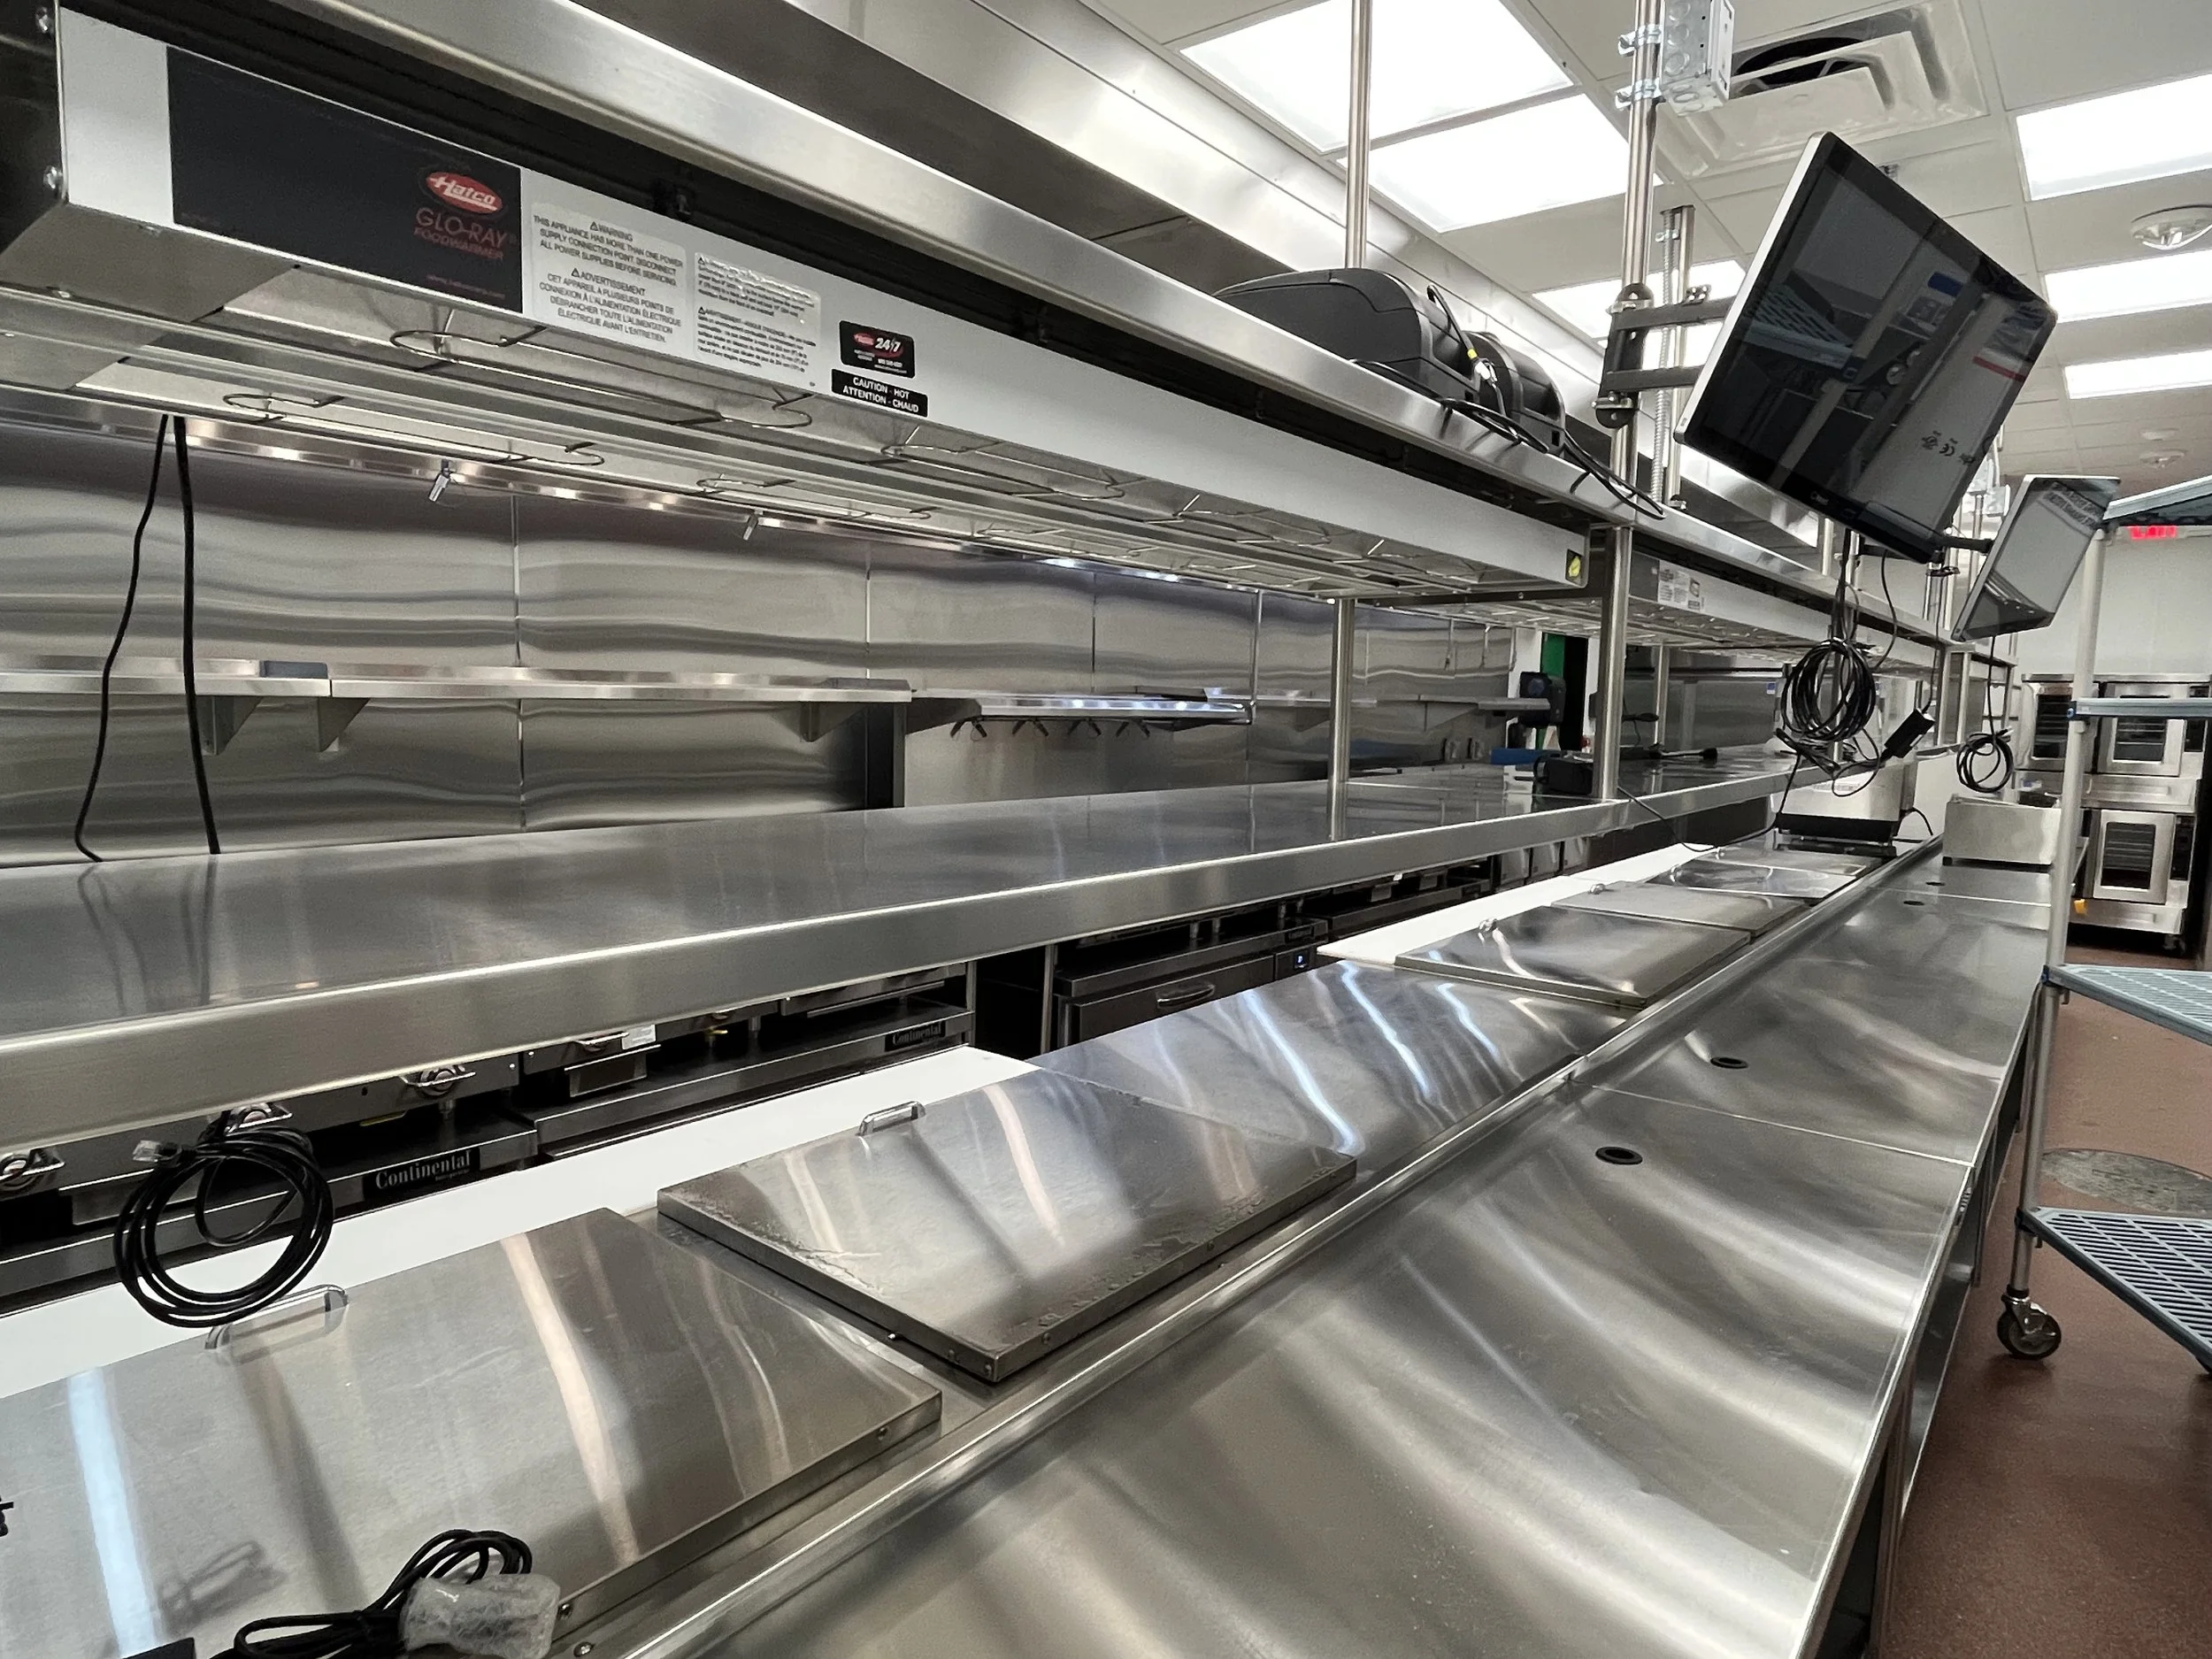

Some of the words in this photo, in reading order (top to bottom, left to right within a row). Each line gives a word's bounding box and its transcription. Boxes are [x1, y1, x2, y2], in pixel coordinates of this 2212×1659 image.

[429, 177, 497, 211] Hatco
[414, 227, 503, 262] FOODWARMER
[416, 207, 507, 248] GLO-RAY
[534, 215, 549, 227] THIS
[551, 221, 588, 239] APPLIANCE
[591, 233, 604, 243] HAS
[606, 237, 625, 250] MORE
[627, 244, 644, 255] THAN
[645, 250, 659, 260] ONE
[660, 254, 683, 267] POWER
[599, 224, 634, 242] WARNING
[540, 228, 566, 242] SUPPLY
[568, 237, 612, 256] CONNECTION
[636, 257, 676, 275] DISCONNECT
[541, 240, 553, 250] ALL
[555, 243, 580, 257] POWER
[582, 252, 613, 267] SUPPLIES
[615, 262, 641, 275] BEFORE
[540, 282, 581, 299] CONNEXION
[589, 296, 641, 315] L'ALIMENTATION
[548, 273, 561, 283] CET
[564, 278, 596, 294] APPAREIL
[603, 288, 640, 305] PLUSIEURS
[641, 299, 664, 311] POINTS
[665, 306, 674, 315] DE
[600, 309, 621, 321] TOUTE
[623, 314, 672, 334] L'ALIMENTATION
[603, 320, 623, 332] AVANT
[843, 385, 886, 403] ATTENTION
[893, 399, 918, 412] CHAUD
[853, 377, 887, 394] CAUTION
[895, 389, 910, 400] HOT
[375, 1149, 471, 1189] Continental
